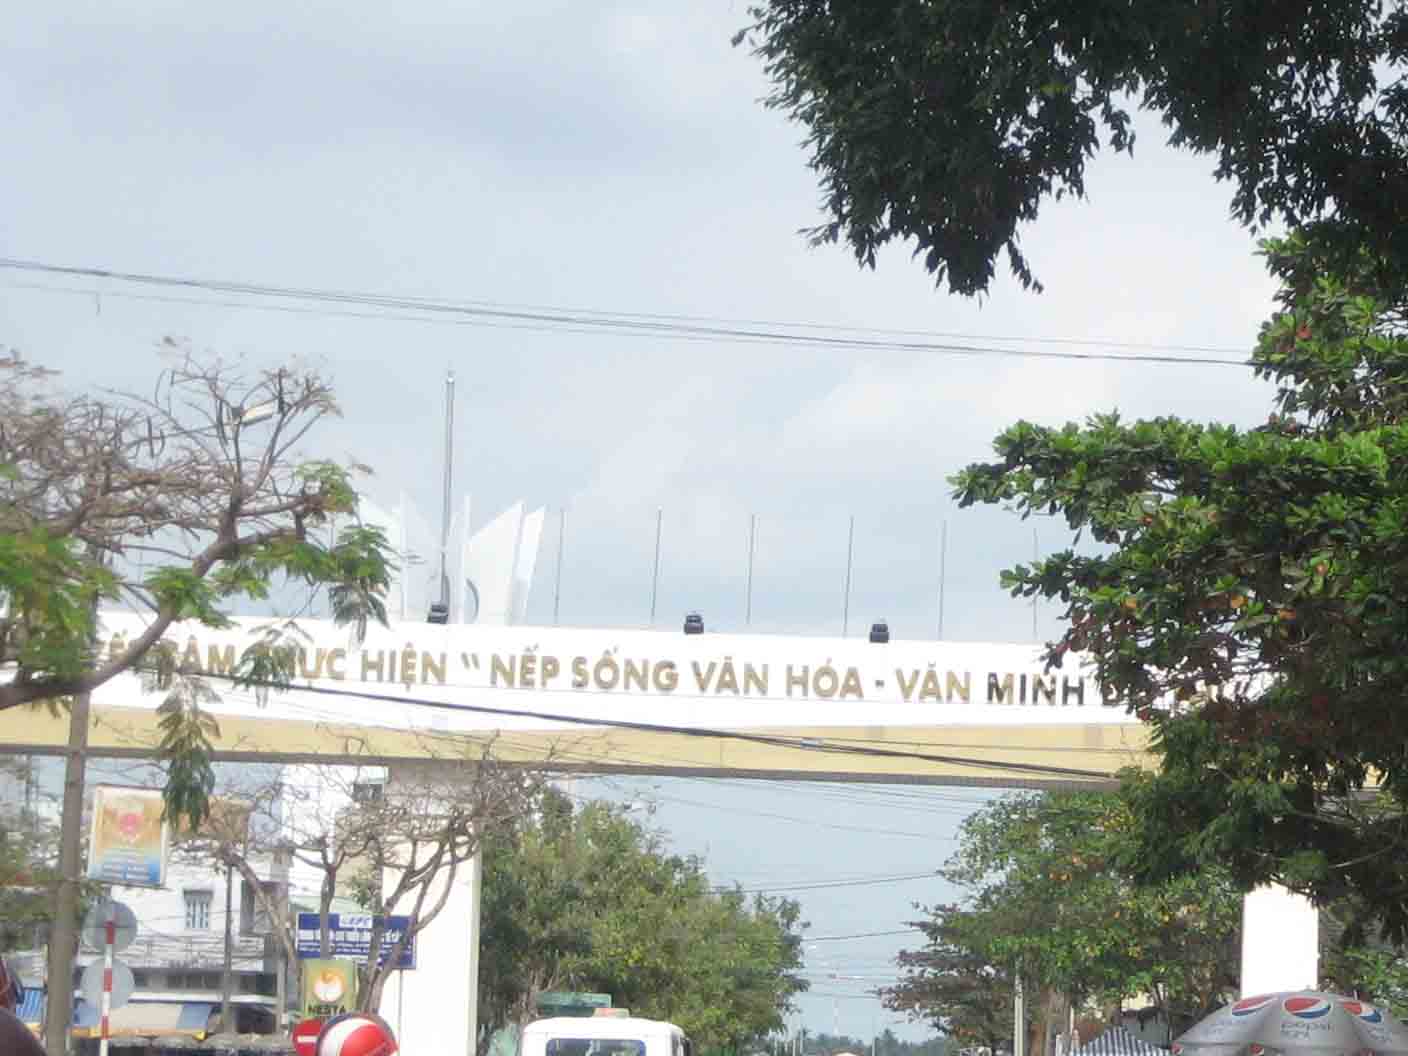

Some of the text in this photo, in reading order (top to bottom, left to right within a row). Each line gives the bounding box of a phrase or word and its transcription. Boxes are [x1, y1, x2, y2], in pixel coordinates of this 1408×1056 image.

[360, 642, 447, 691] HIỆN
[571, 645, 678, 692] SỐNG
[691, 656, 768, 696] VĂN
[785, 658, 863, 699] HÓA
[899, 663, 971, 704] VĂN
[987, 671, 1085, 707] MINH
